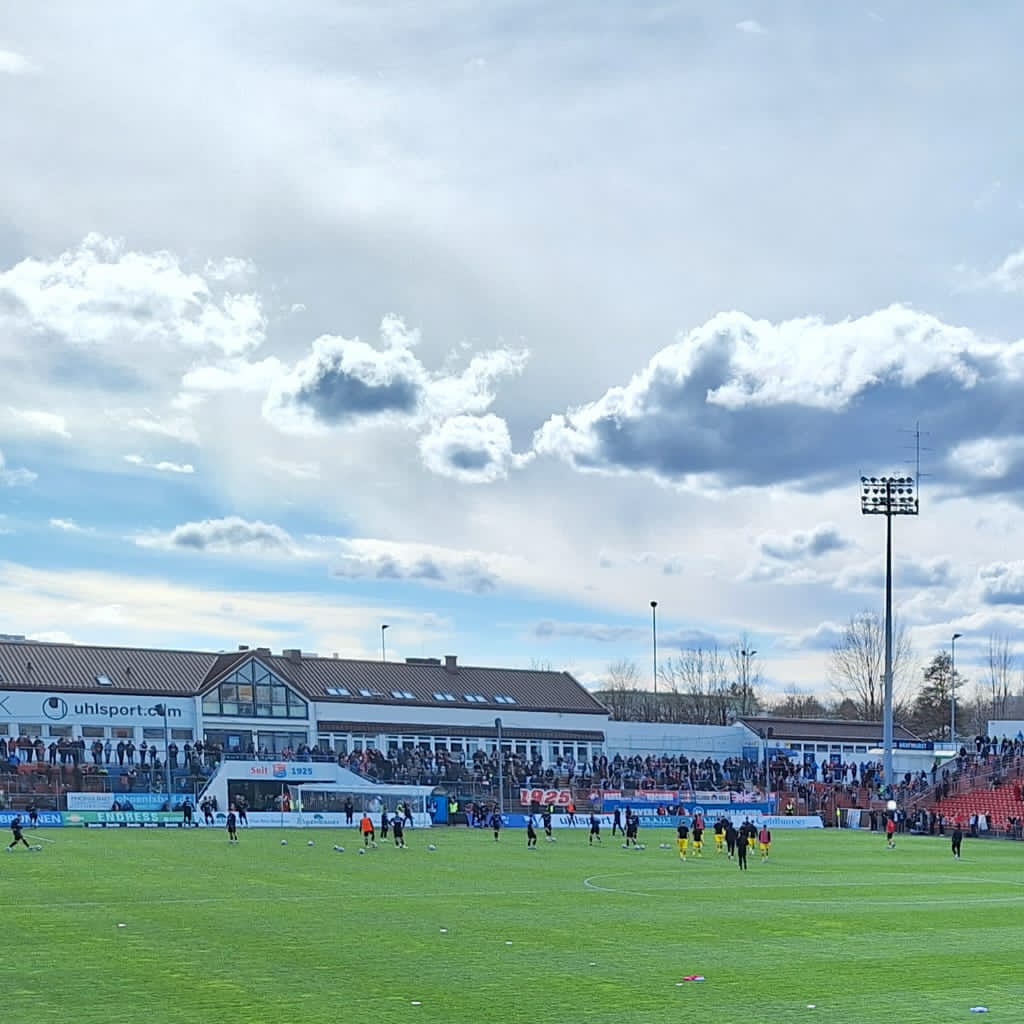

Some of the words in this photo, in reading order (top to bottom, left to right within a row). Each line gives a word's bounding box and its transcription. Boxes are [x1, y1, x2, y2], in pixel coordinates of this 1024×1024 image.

[74, 702, 182, 718] uhlsport.cm
[291, 767, 313, 776] 1925
[520, 788, 572, 806] 1925
